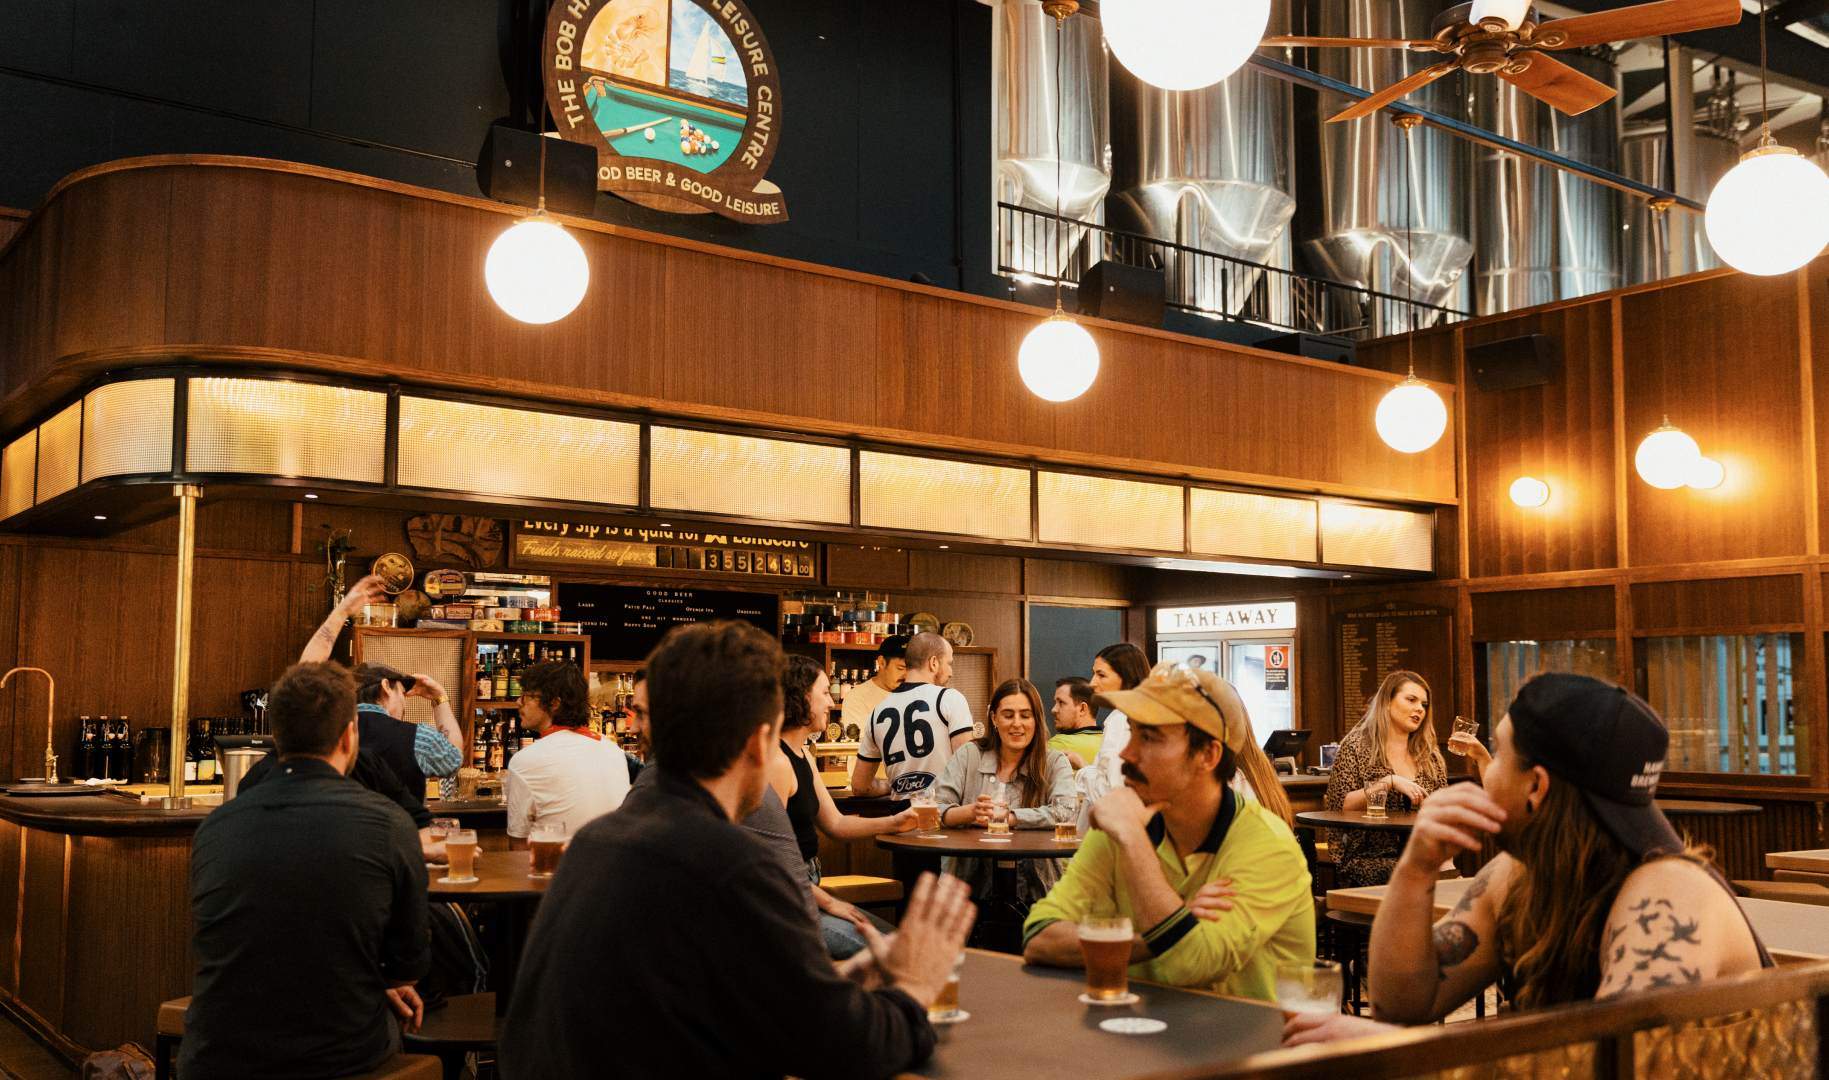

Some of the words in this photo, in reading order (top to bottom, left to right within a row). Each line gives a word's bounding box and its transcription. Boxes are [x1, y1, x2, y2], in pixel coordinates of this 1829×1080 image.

[556, 20, 577, 71] BOB
[558, 79, 585, 129] THE
[712, 0, 768, 77] LEISURE
[740, 85, 772, 170] CENTRE
[598, 166, 621, 180] OD
[625, 166, 662, 183] BEER
[665, 171, 676, 187] &
[680, 177, 722, 203] GOOD
[725, 195, 780, 216] LEISURE
[522, 540, 560, 557] Funds
[562, 544, 606, 560] raised
[605, 551, 617, 560] so
[1174, 607, 1279, 627] TAKEAWAY
[876, 699, 935, 767] 26
[896, 776, 925, 793] Ford
